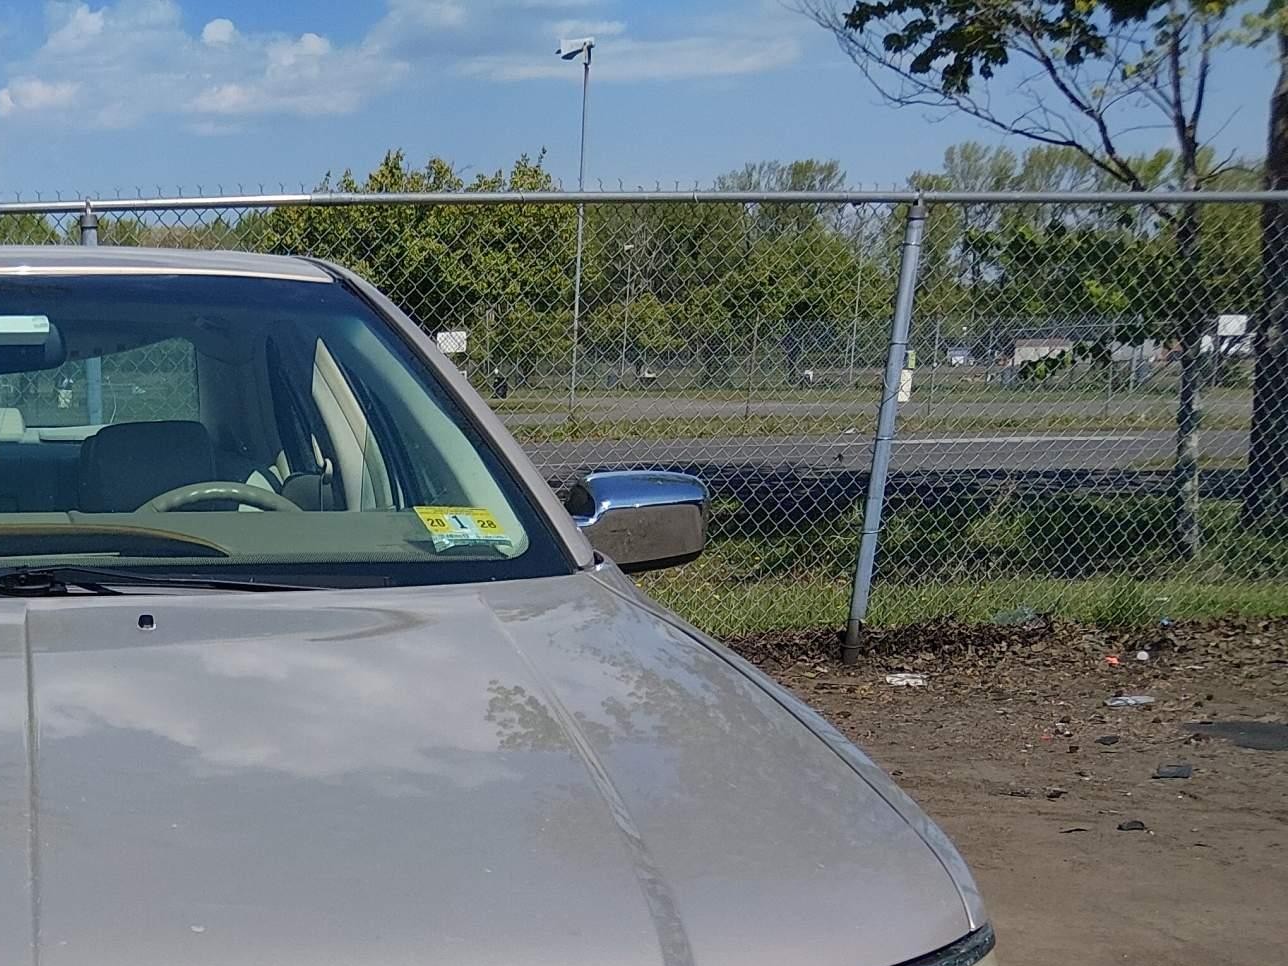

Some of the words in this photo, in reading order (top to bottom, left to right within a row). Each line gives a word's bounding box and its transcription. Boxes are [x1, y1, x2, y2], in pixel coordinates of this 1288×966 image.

[426, 518, 446, 528] 20
[451, 515, 469, 529] 1
[476, 519, 497, 529] 28
